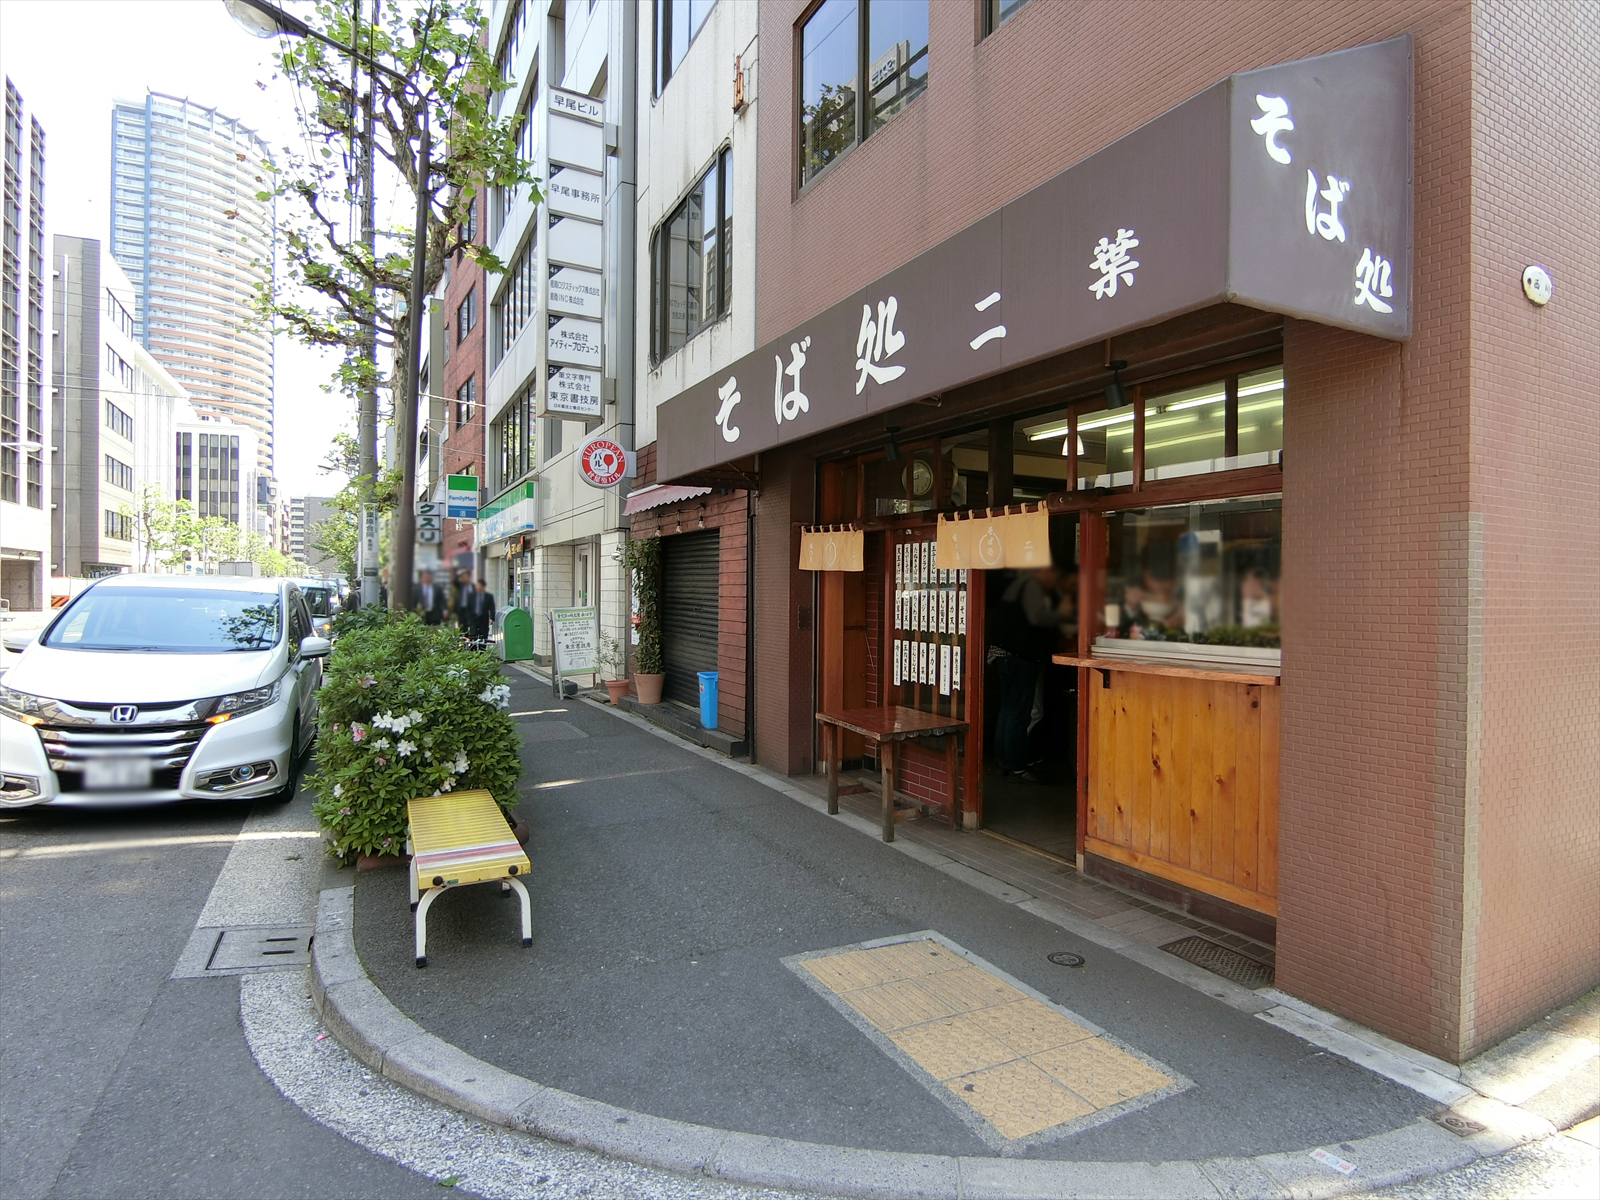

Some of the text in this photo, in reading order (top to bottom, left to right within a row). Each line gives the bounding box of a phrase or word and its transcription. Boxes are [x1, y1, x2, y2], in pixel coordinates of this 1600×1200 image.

[554, 94, 599, 117] 早尾ビル
[550, 183, 600, 204] 早尾事務所
[1249, 93, 1394, 314] そば処
[560, 330, 589, 343] 株式会社
[550, 338, 599, 354] アイティープロデュース
[558, 380, 591, 392] 株式会社
[549, 391, 599, 405] 東京書技房
[582, 441, 625, 462] EUROPEAN
[593, 452, 603, 468] バル
[420, 503, 435, 541] クスリ
